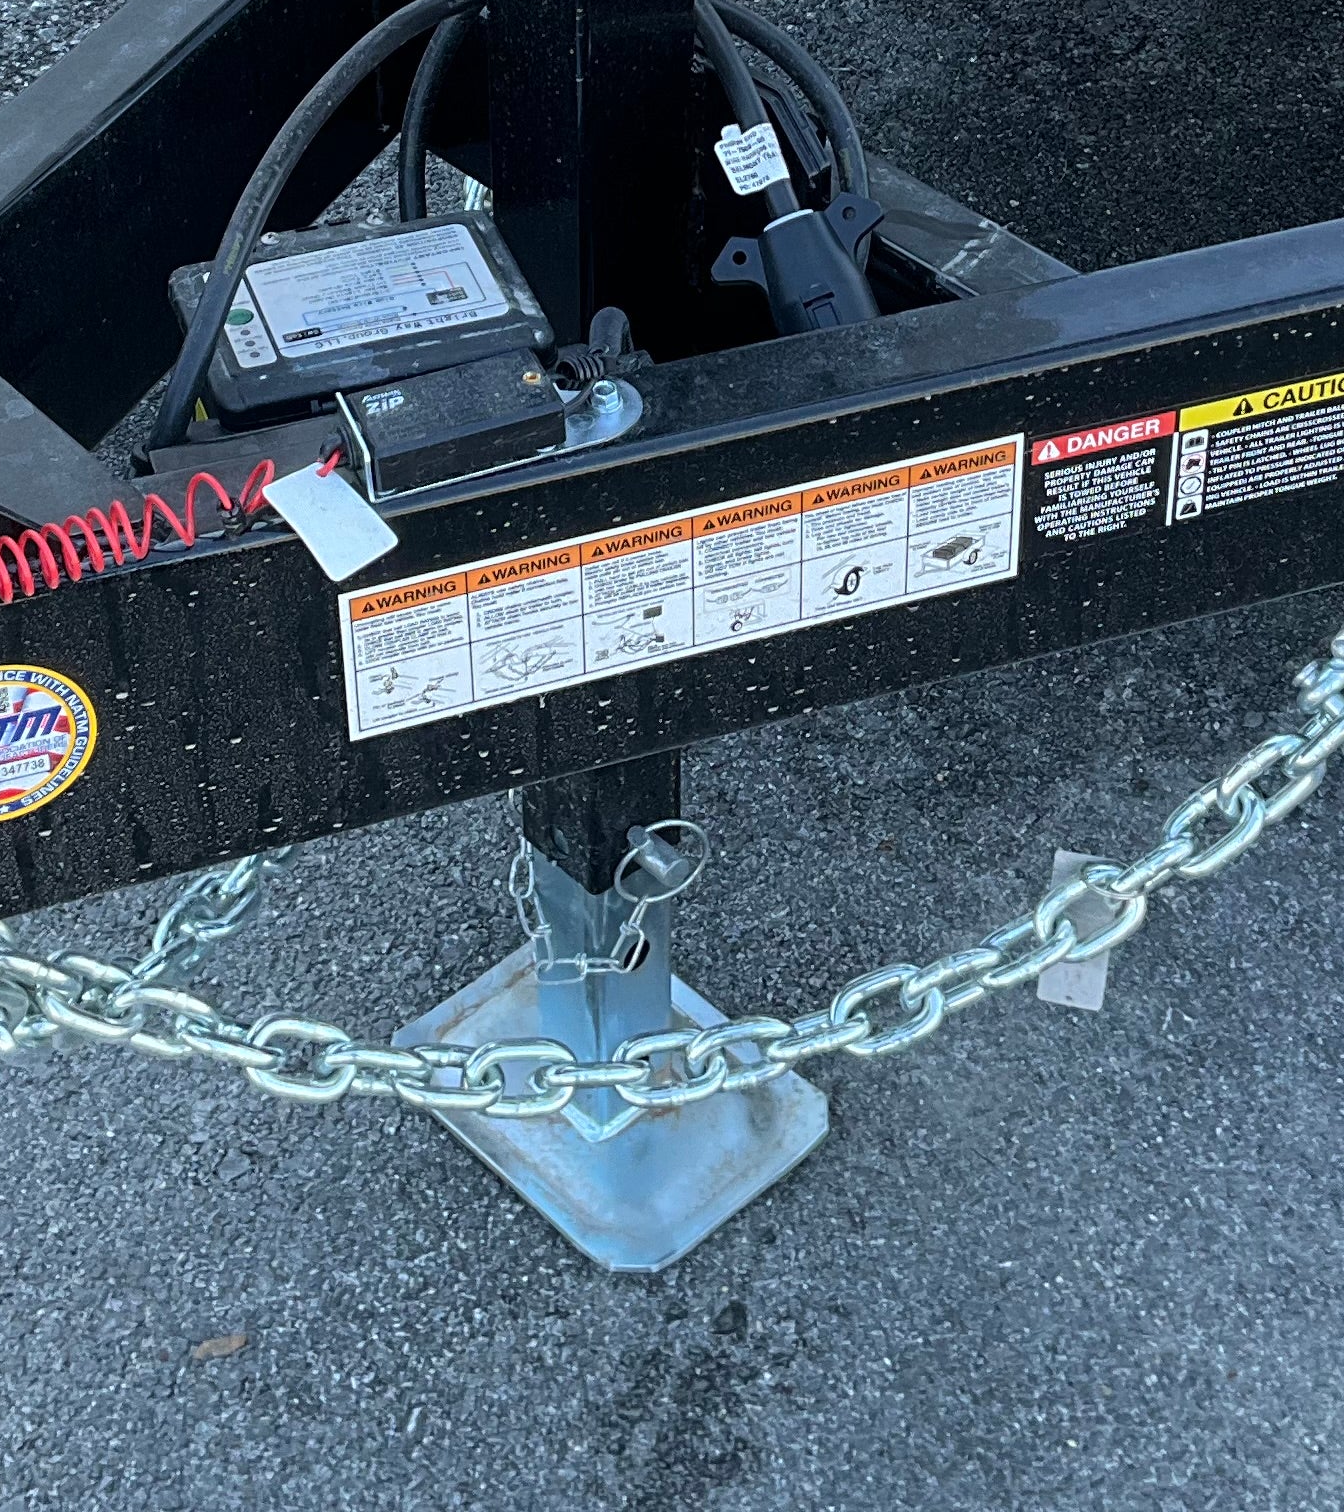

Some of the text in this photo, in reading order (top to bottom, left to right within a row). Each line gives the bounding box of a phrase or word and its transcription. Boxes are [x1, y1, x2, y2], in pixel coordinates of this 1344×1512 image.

[394, 320, 423, 331] Way
[1066, 418, 1160, 453] DANGER
[933, 449, 1006, 476] WARNING
[1043, 464, 1083, 480] SERIOUS
[1084, 456, 1116, 471] INJURY
[1043, 456, 1154, 489] PROPERTY DAMAGE CAN
[826, 473, 899, 501] WARNING
[1046, 482, 1079, 496] RESULT
[1092, 474, 1112, 485] THIS
[1114, 465, 1151, 480] VEHICLE
[1069, 485, 1100, 499] TOWED
[1103, 477, 1138, 491] BEFORE
[717, 499, 791, 527] WARNING
[1033, 512, 1057, 524] WITH
[1060, 507, 1077, 518] THE
[1036, 513, 1088, 532] OPERATING
[1045, 507, 1146, 538] AND CAUTIONS LISTED
[605, 525, 682, 553] WARNING
[1078, 527, 1095, 538] THE
[492, 552, 570, 581] WARNING
[375, 579, 456, 609] WARNING
[30, 672, 69, 697] WITH
[65, 696, 88, 734] NATM
[1, 758, 45, 777] 347738
[21, 736, 88, 807] GUIDELINES
